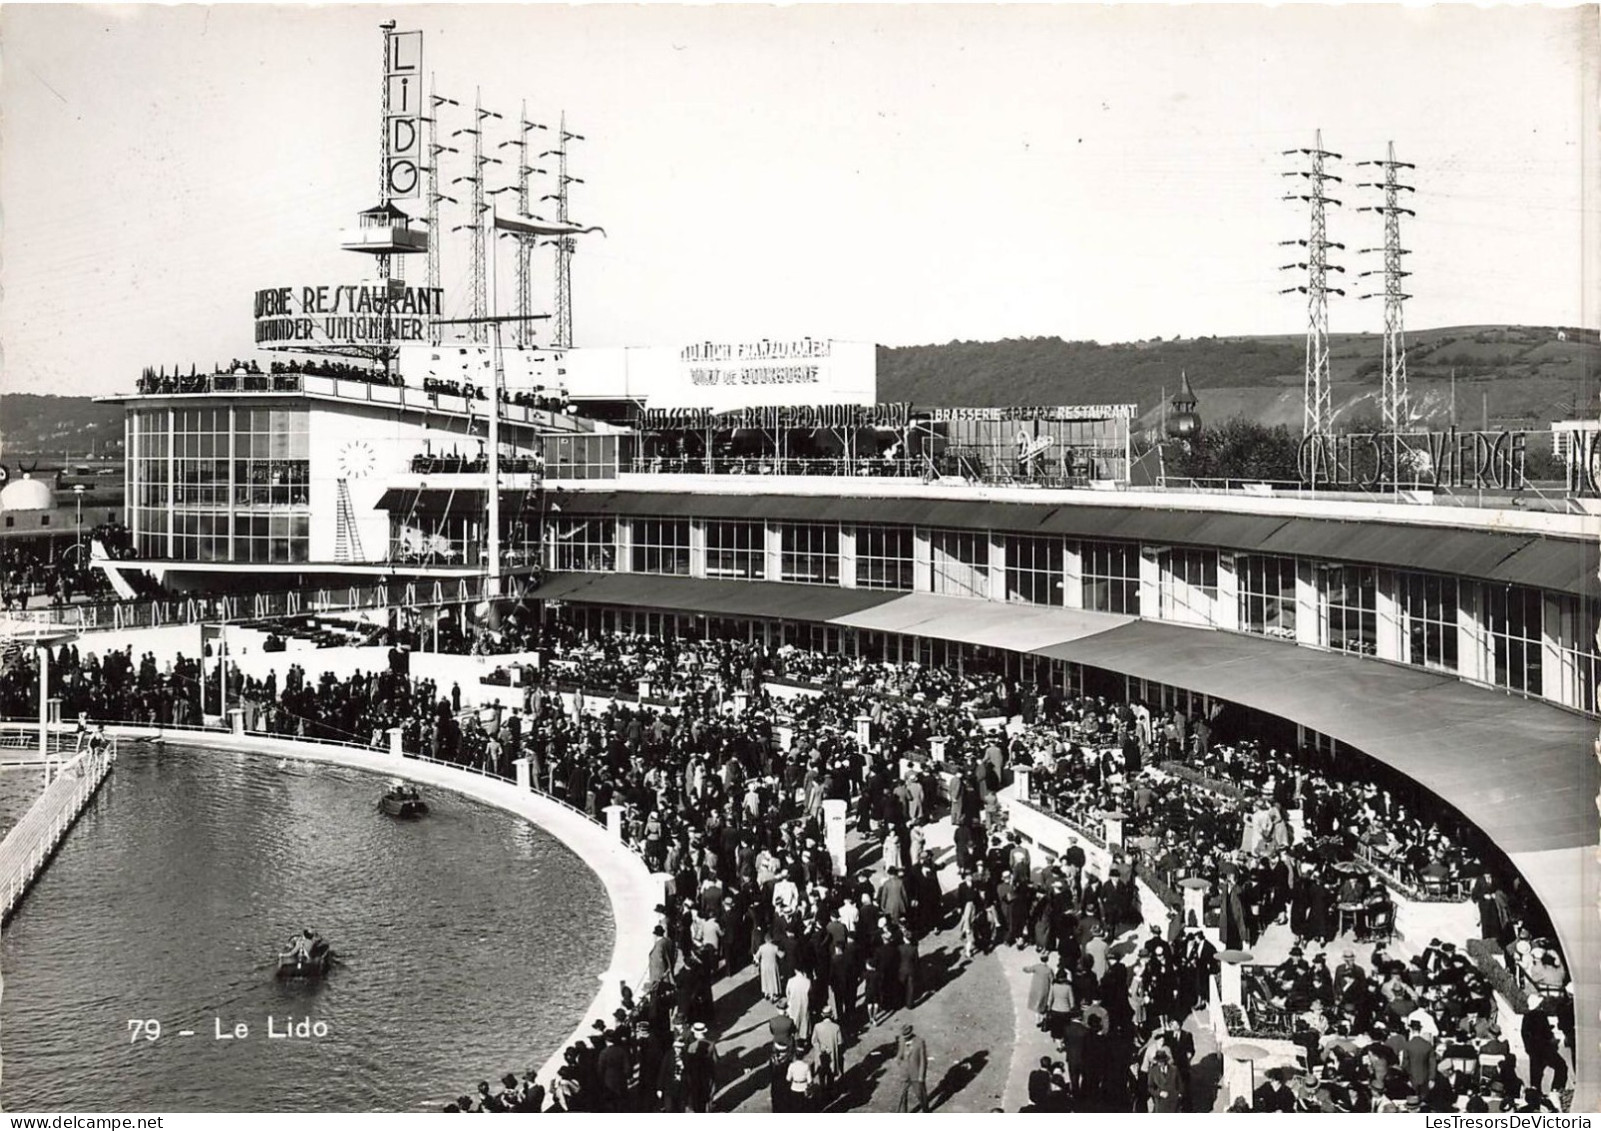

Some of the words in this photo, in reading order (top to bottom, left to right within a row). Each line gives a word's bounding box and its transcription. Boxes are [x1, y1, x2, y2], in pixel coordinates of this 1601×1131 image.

[303, 284, 444, 315] RESTAURANT
[935, 407, 1001, 421] BRASSERIE
[1057, 403, 1138, 419] RESTAURANT
